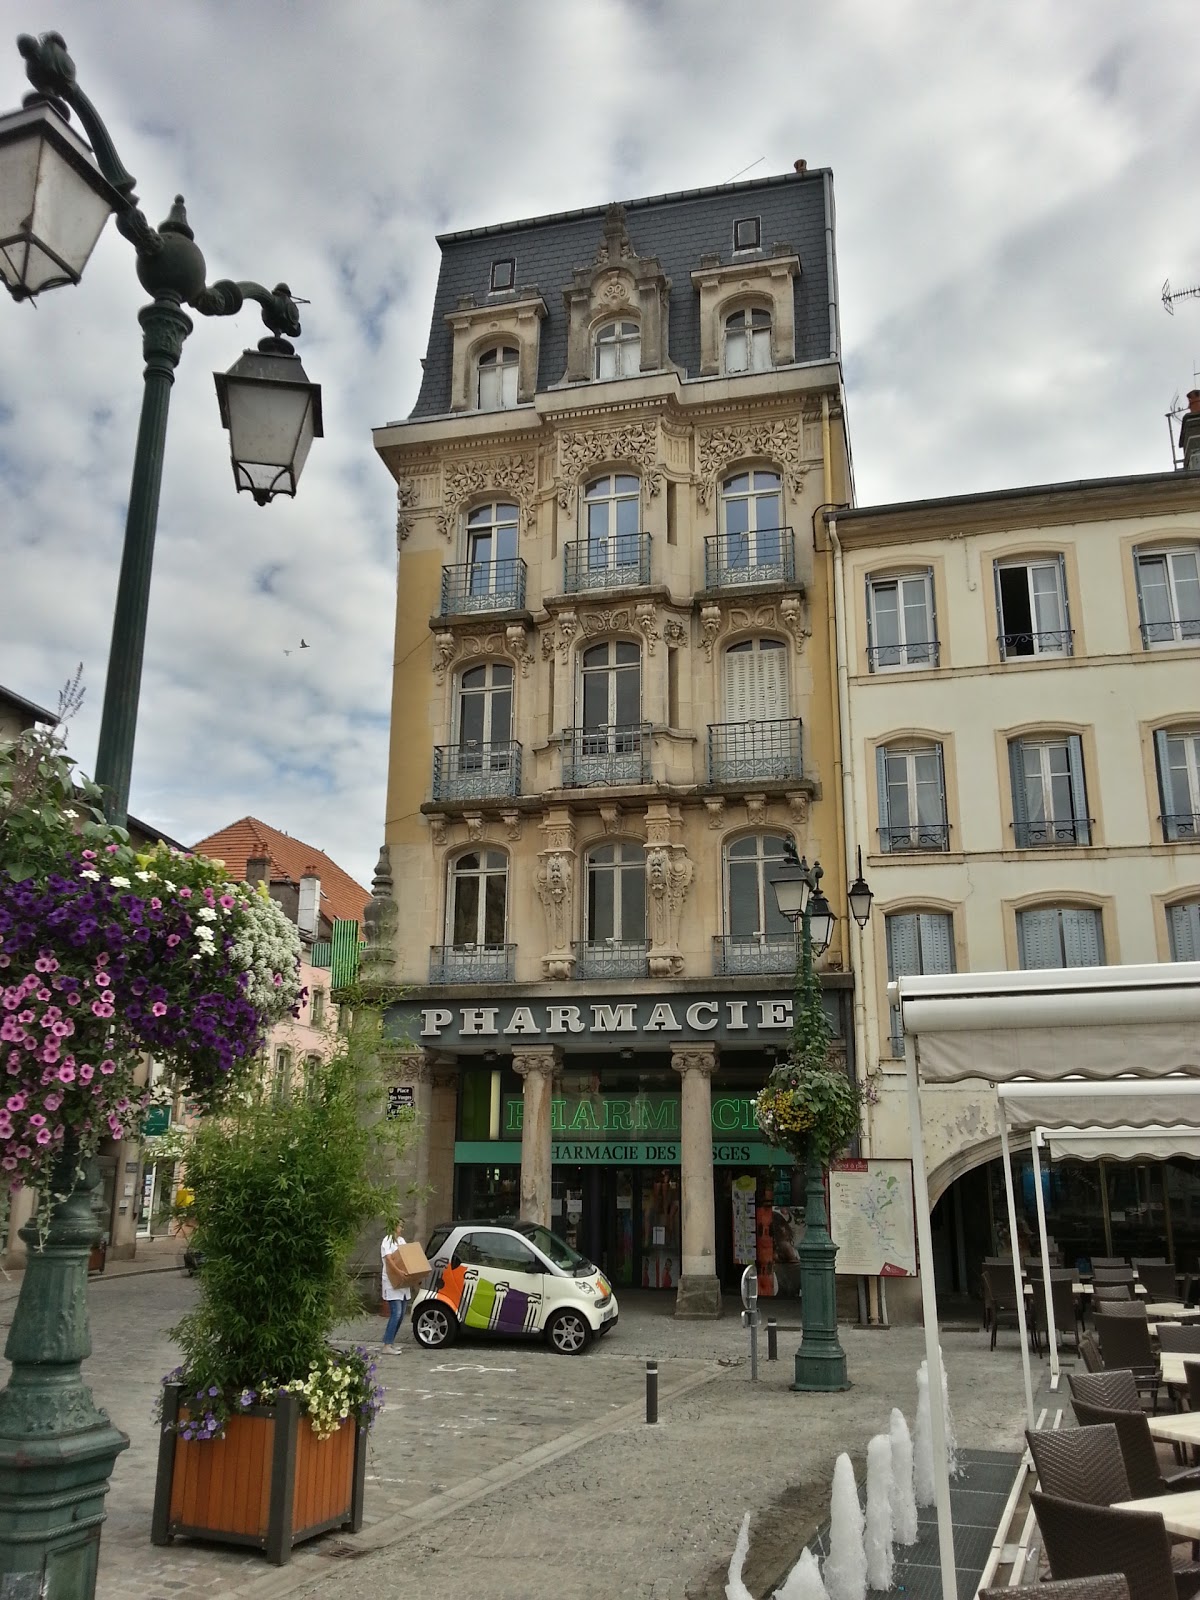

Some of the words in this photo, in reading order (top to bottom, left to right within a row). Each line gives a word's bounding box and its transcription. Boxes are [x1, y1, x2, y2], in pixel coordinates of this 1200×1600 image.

[604, 284, 626, 298] 1900
[420, 1000, 794, 1036] PHARMACIE
[552, 1145, 638, 1160] HARMACIE
[645, 1145, 677, 1160] DES
